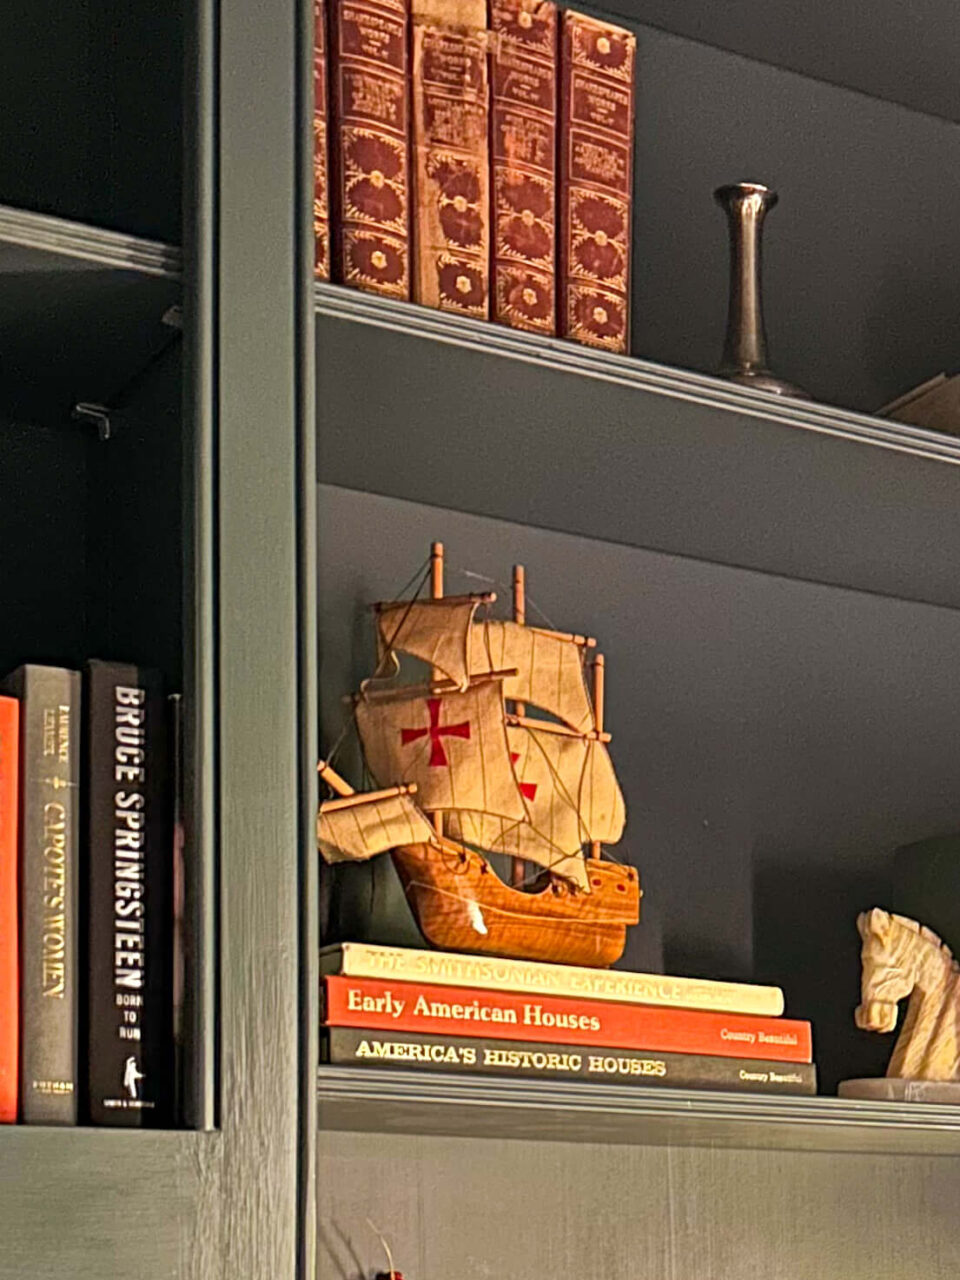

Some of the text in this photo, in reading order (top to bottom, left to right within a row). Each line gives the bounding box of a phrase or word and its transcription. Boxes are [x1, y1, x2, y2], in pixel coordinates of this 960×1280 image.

[115, 685, 145, 989] BRUCE SPRINGSTEEN
[43, 913, 65, 999] WOMEN
[365, 950, 405, 971] THE
[416, 955, 560, 987] SMITHSONIAN
[570, 970, 682, 999] EXPERIENCE
[116, 994, 143, 1007] BORN
[123, 1011, 137, 1023] TO
[347, 989, 601, 1032] Early American Houses
[119, 1026, 141, 1041] RUN
[355, 1040, 667, 1077] AMERICA'S HISTORIC HOUSES
